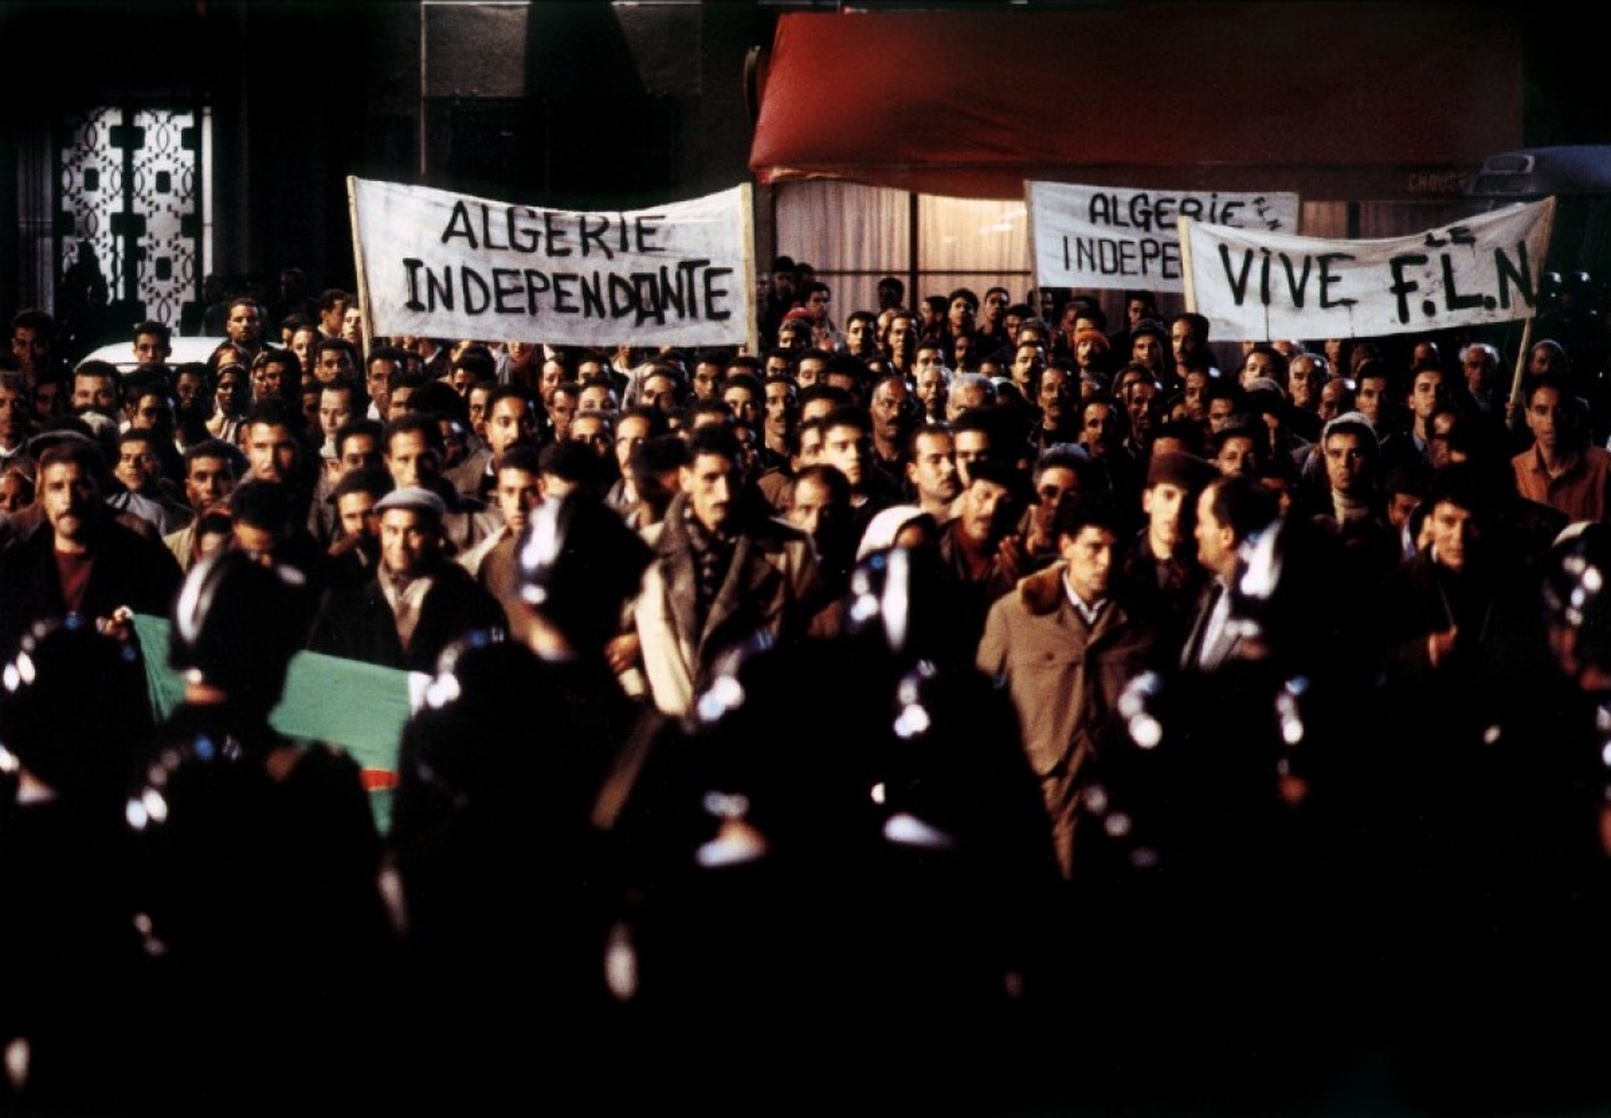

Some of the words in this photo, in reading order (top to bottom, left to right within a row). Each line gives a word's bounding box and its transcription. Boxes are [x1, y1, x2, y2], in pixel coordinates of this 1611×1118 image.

[441, 200, 667, 259] ALGERIE
[1424, 226, 1476, 247] LE
[1063, 235, 1183, 279] INDEPE
[402, 257, 733, 326] INDEPENDANTE
